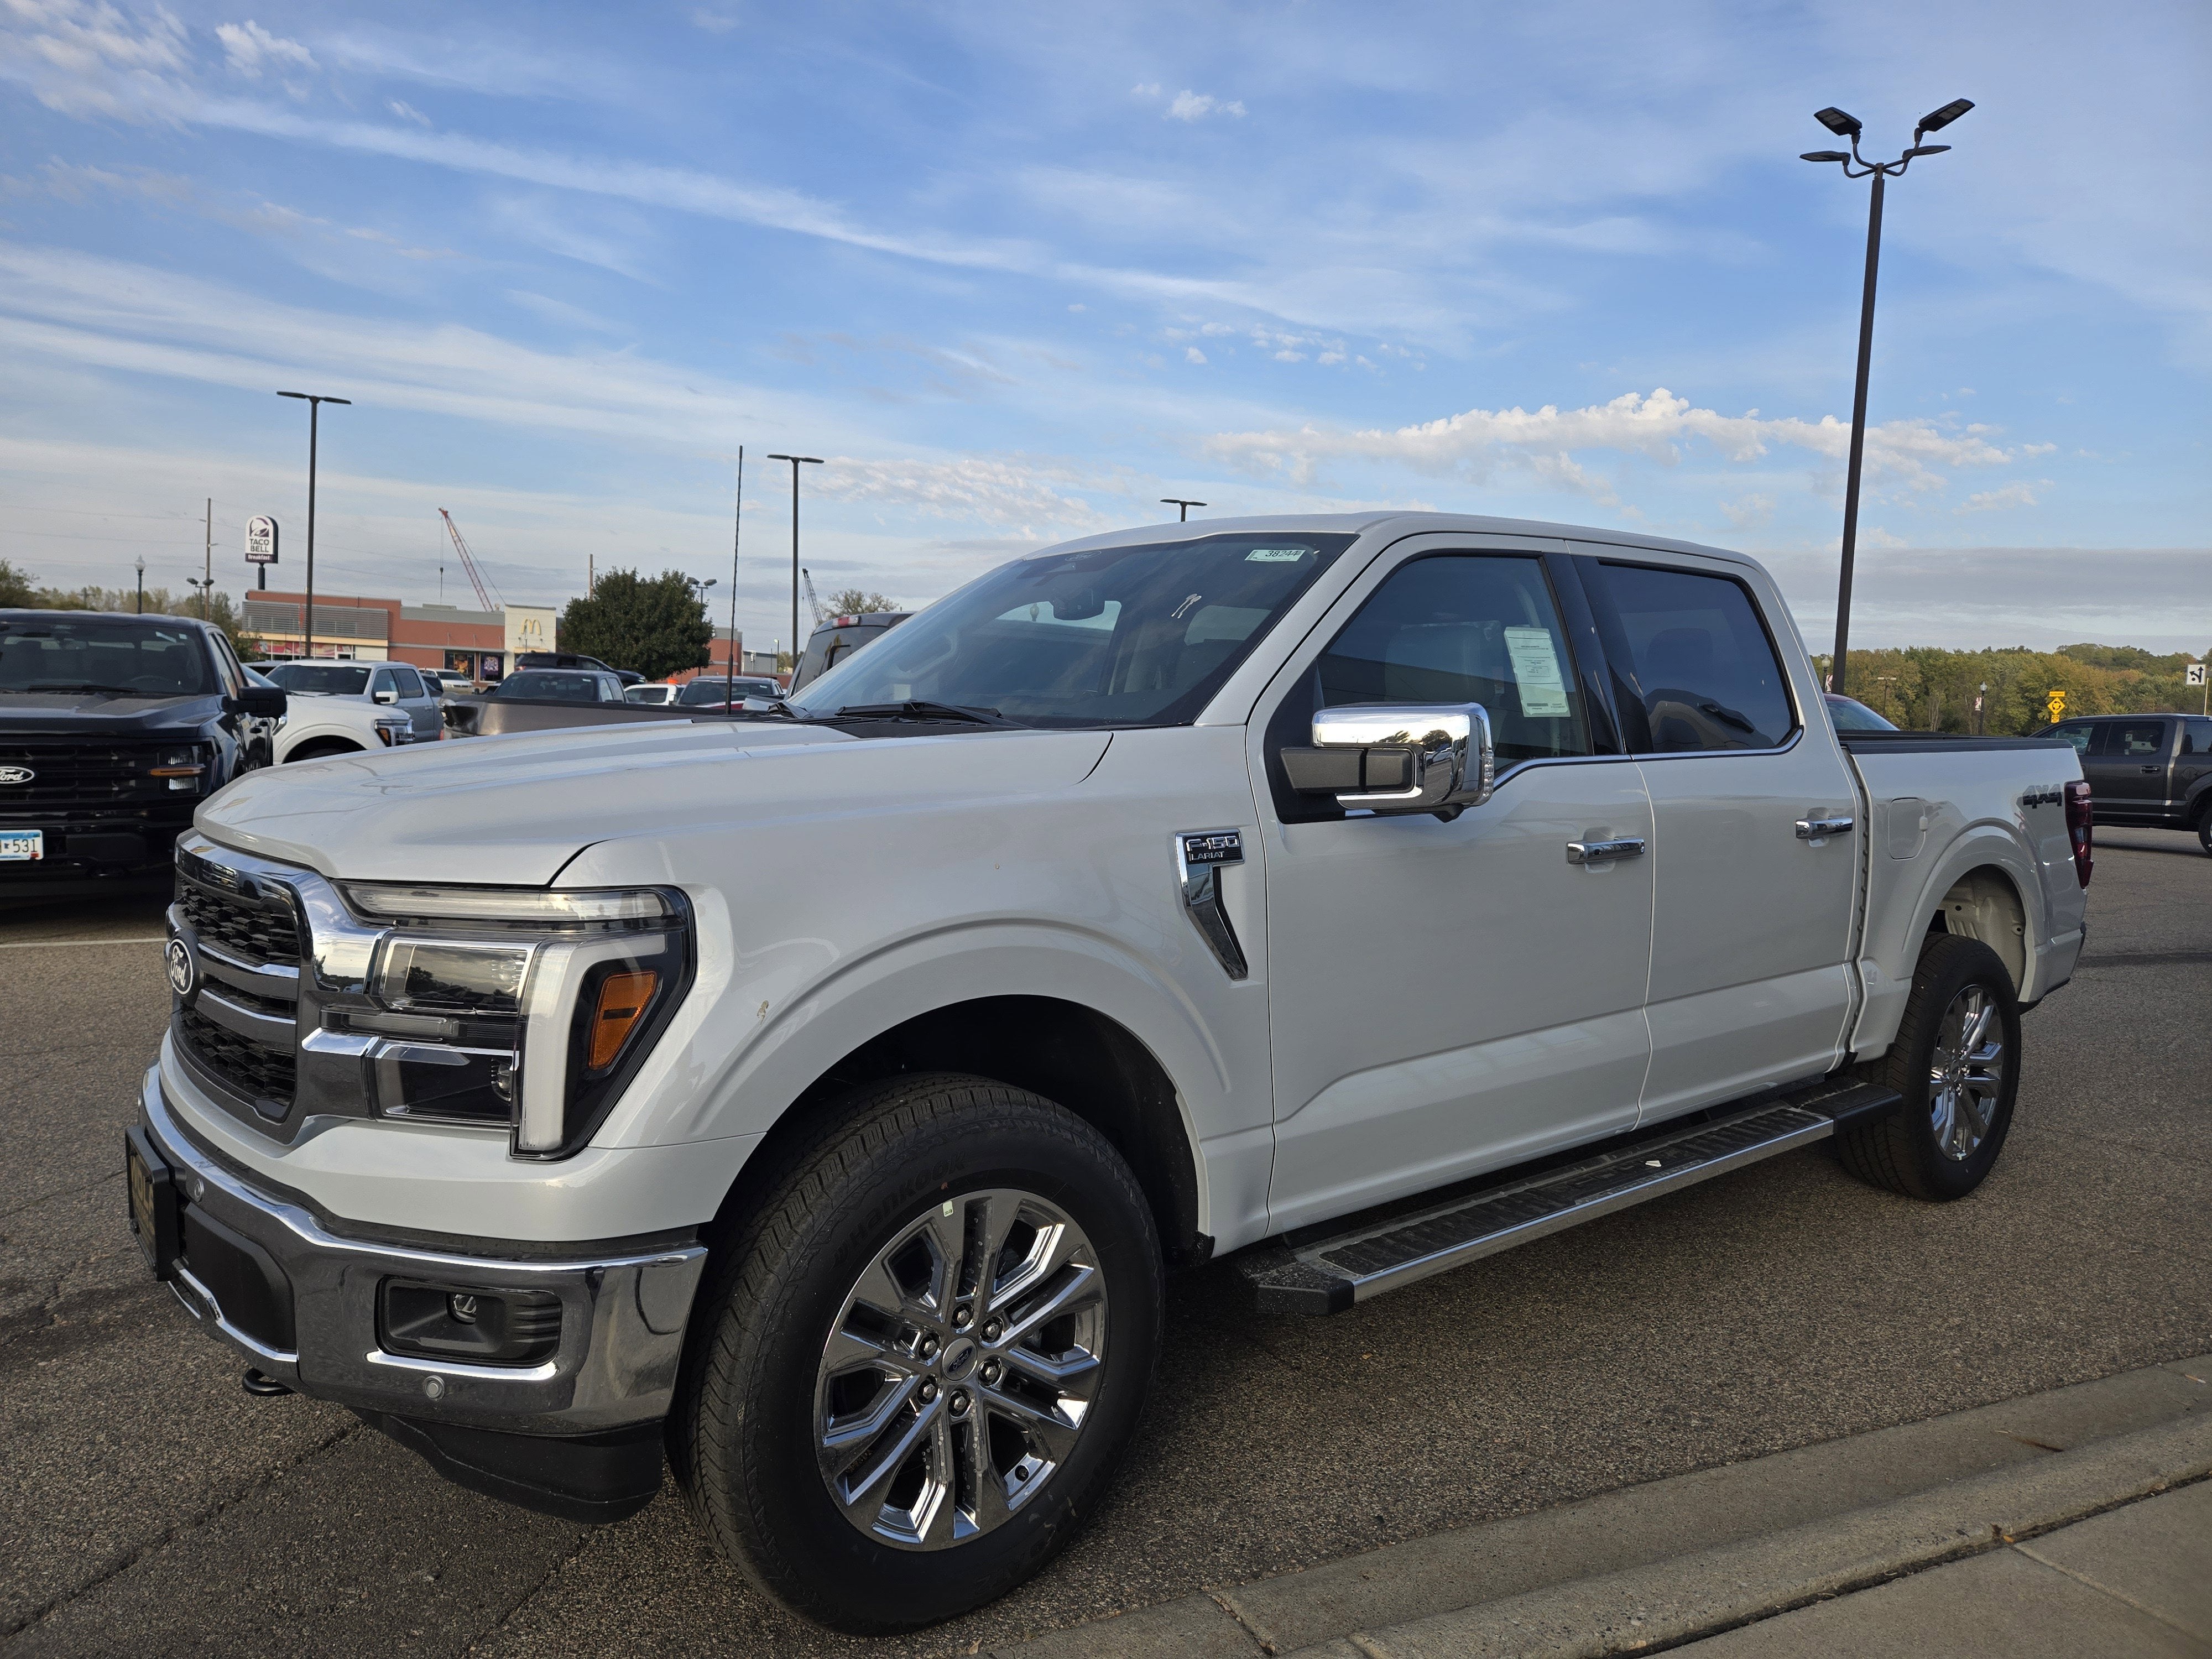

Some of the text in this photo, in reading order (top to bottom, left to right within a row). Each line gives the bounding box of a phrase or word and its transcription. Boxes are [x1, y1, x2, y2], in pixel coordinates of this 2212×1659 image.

[13, 839, 38, 853] 531
[1186, 836, 1240, 852] F-150
[1191, 851, 1225, 860] LARIAT
[170, 945, 187, 988] Ford
[952, 1350, 969, 1370] Ford
